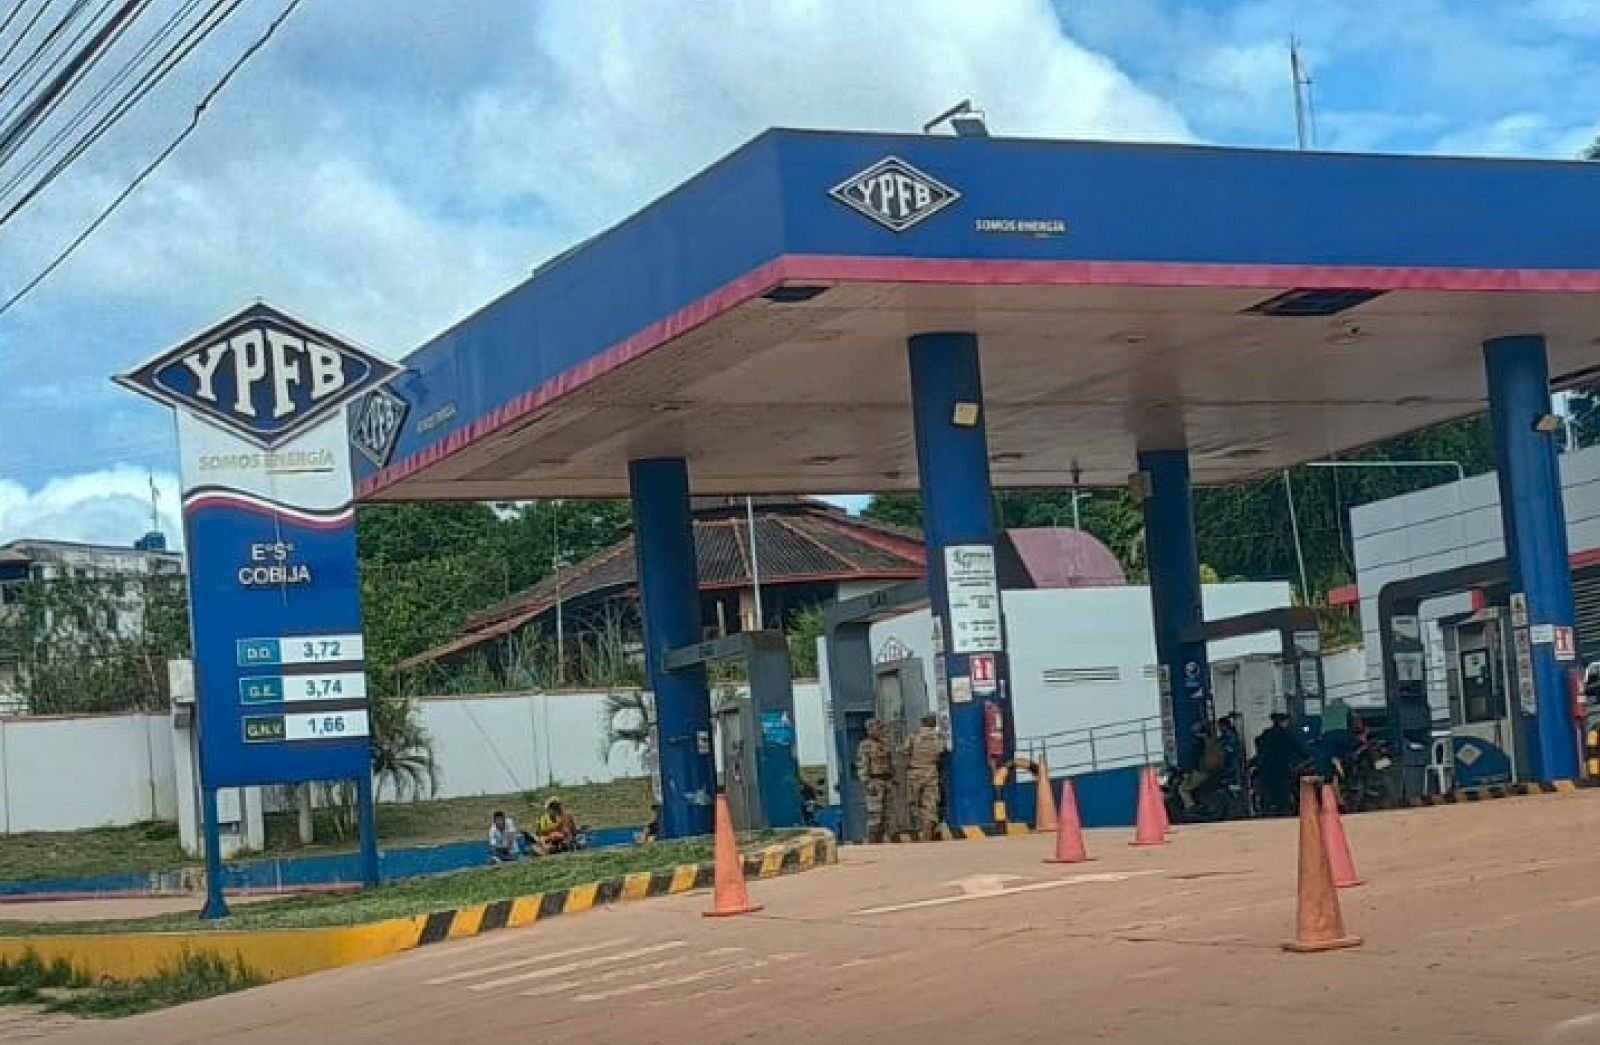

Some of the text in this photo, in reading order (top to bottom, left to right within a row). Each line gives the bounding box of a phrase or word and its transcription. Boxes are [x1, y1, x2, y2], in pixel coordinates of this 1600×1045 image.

[857, 173, 931, 217] YPFB
[183, 328, 346, 417] YPFB
[198, 454, 260, 471] SOMOS
[238, 565, 311, 585] COBIJA
[303, 641, 342, 660] 3,72
[305, 679, 343, 697] 3,74
[307, 716, 345, 734] 1,66
